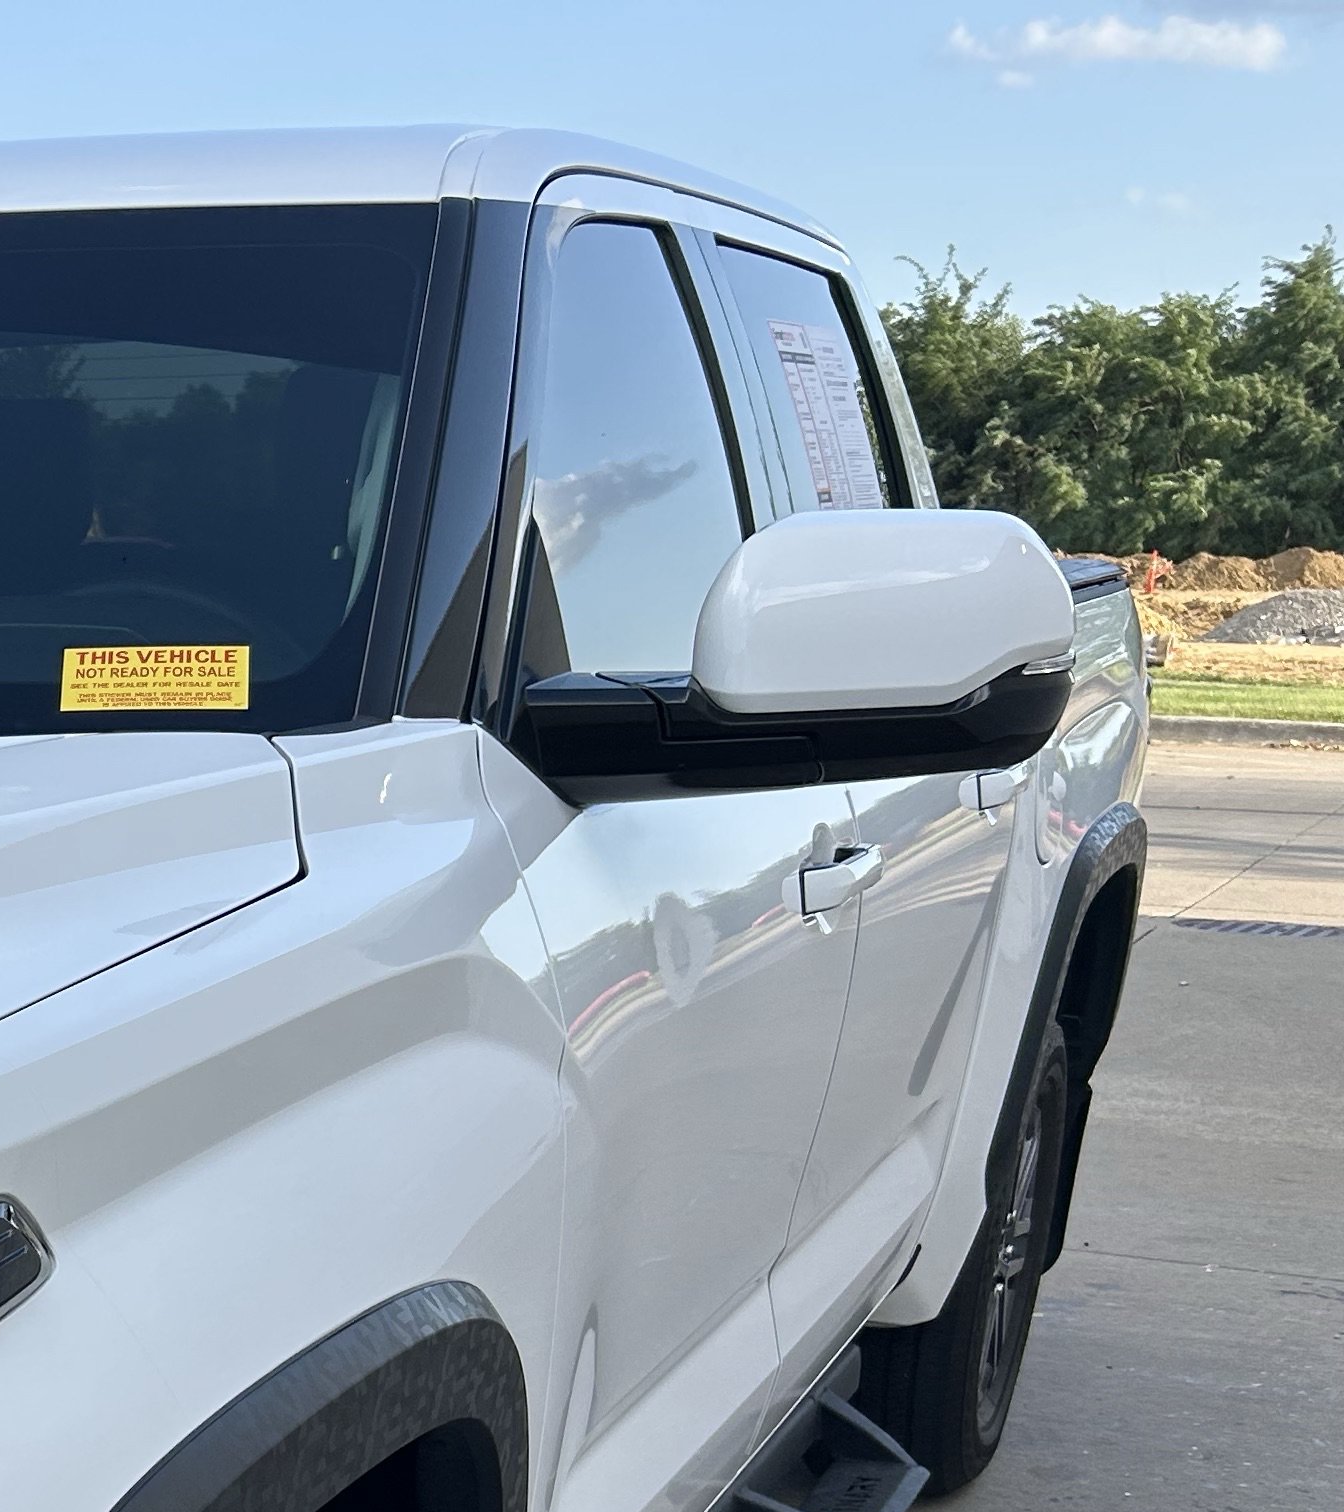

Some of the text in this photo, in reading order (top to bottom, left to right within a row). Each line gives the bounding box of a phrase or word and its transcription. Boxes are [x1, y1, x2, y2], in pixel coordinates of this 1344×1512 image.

[76, 649, 238, 665] THIS VEHICLE
[75, 666, 236, 679] NOT READY FOR SALE
